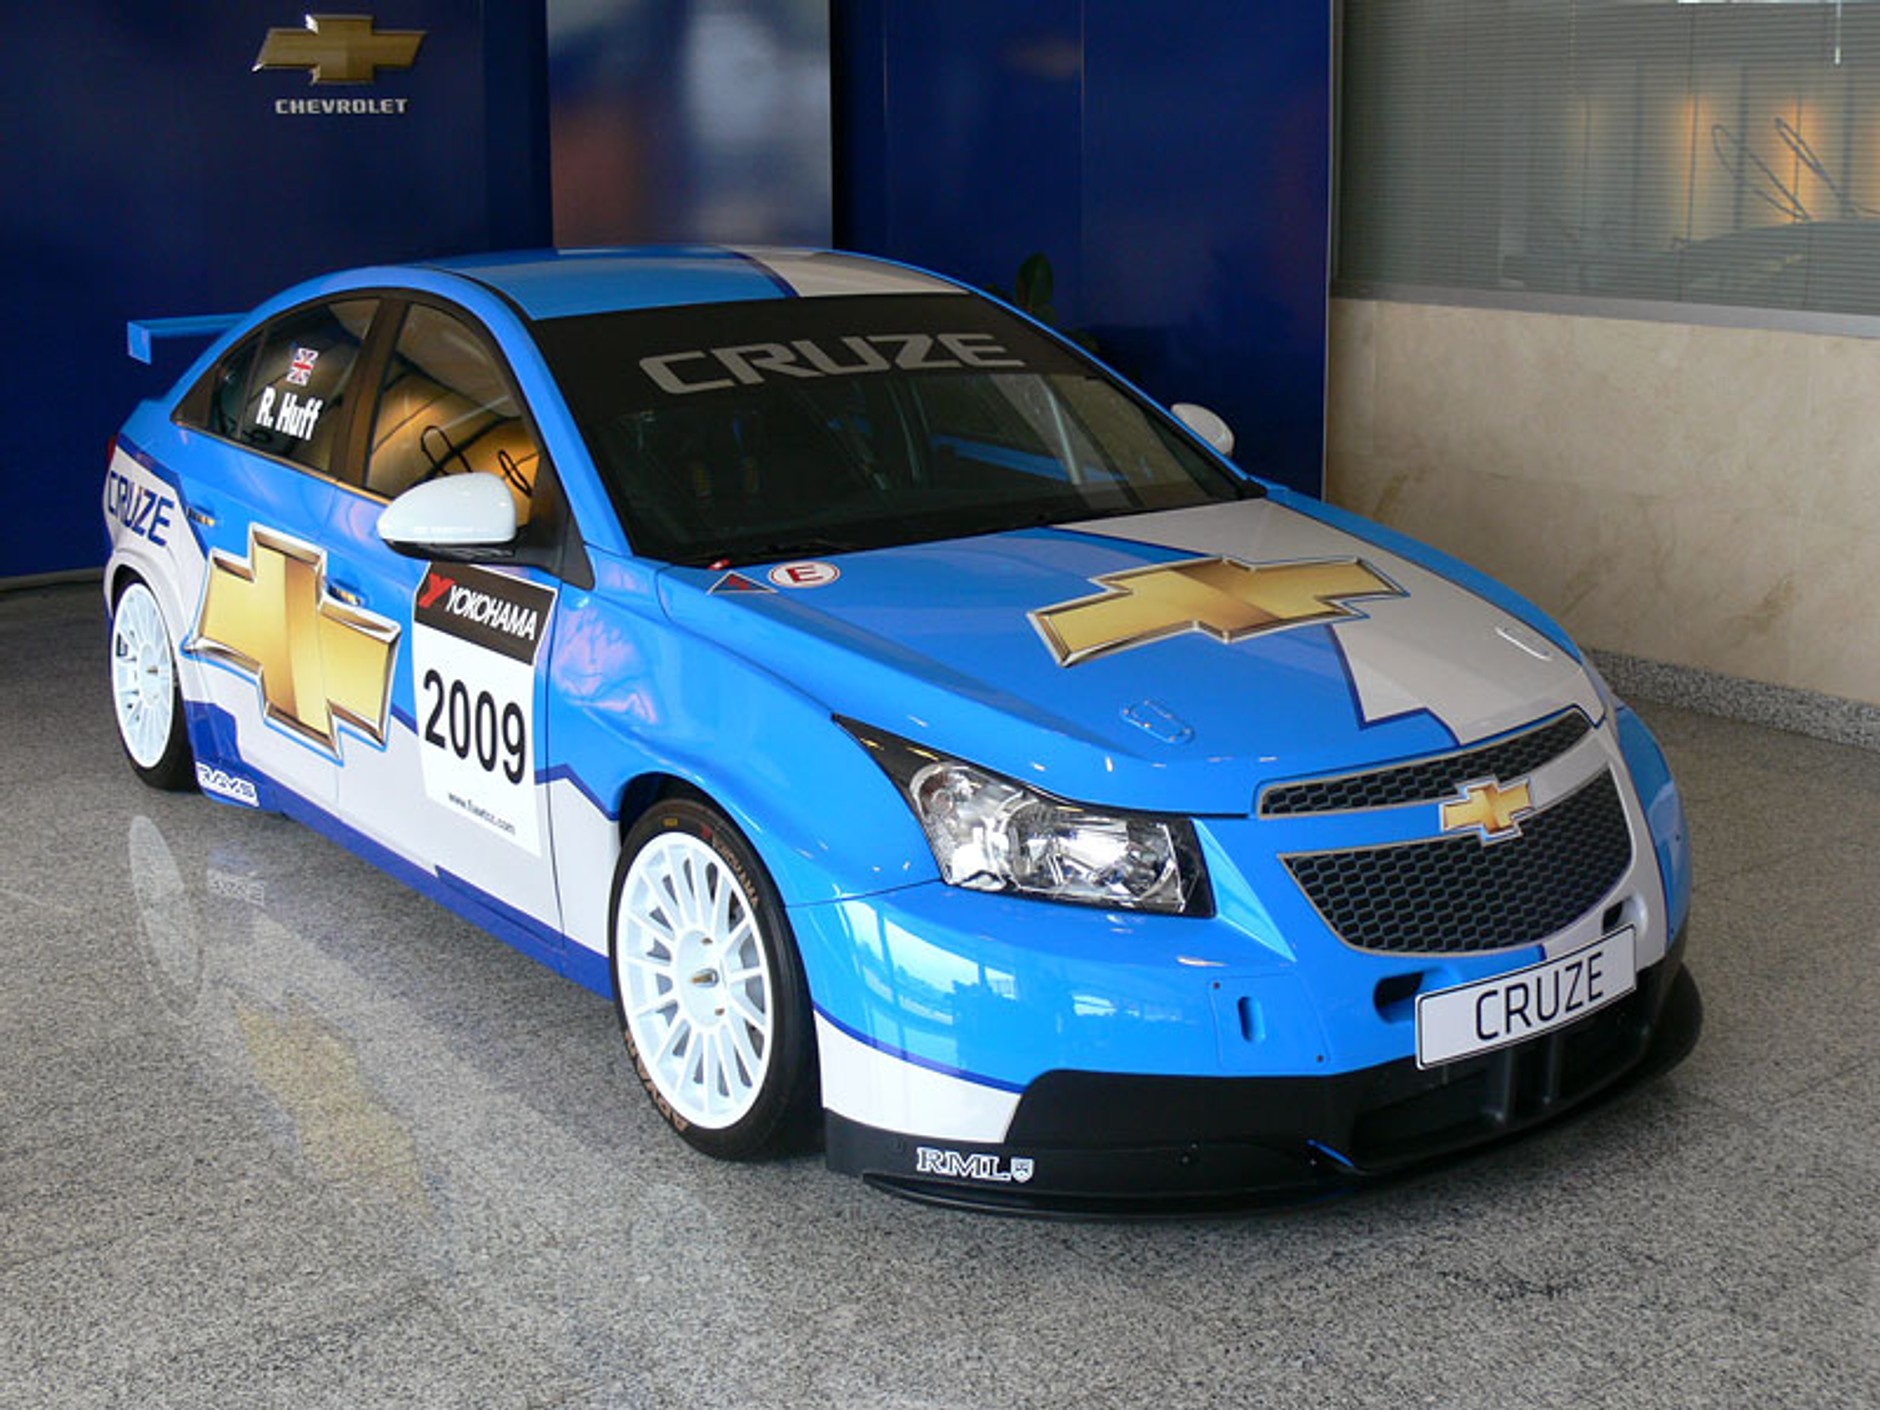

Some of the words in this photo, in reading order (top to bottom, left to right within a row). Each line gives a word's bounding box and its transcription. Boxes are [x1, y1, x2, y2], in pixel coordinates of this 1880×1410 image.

[274, 98, 409, 115] CHEVROLET
[638, 333, 1027, 395] CRUZE
[256, 386, 275, 429] R.
[275, 392, 323, 441] Huff
[108, 470, 175, 547] CRUZE
[445, 585, 538, 640] YOKOHAMA
[423, 668, 527, 786] 2009
[1475, 951, 1604, 1041] CRUZE
[915, 1146, 1012, 1182] RML
